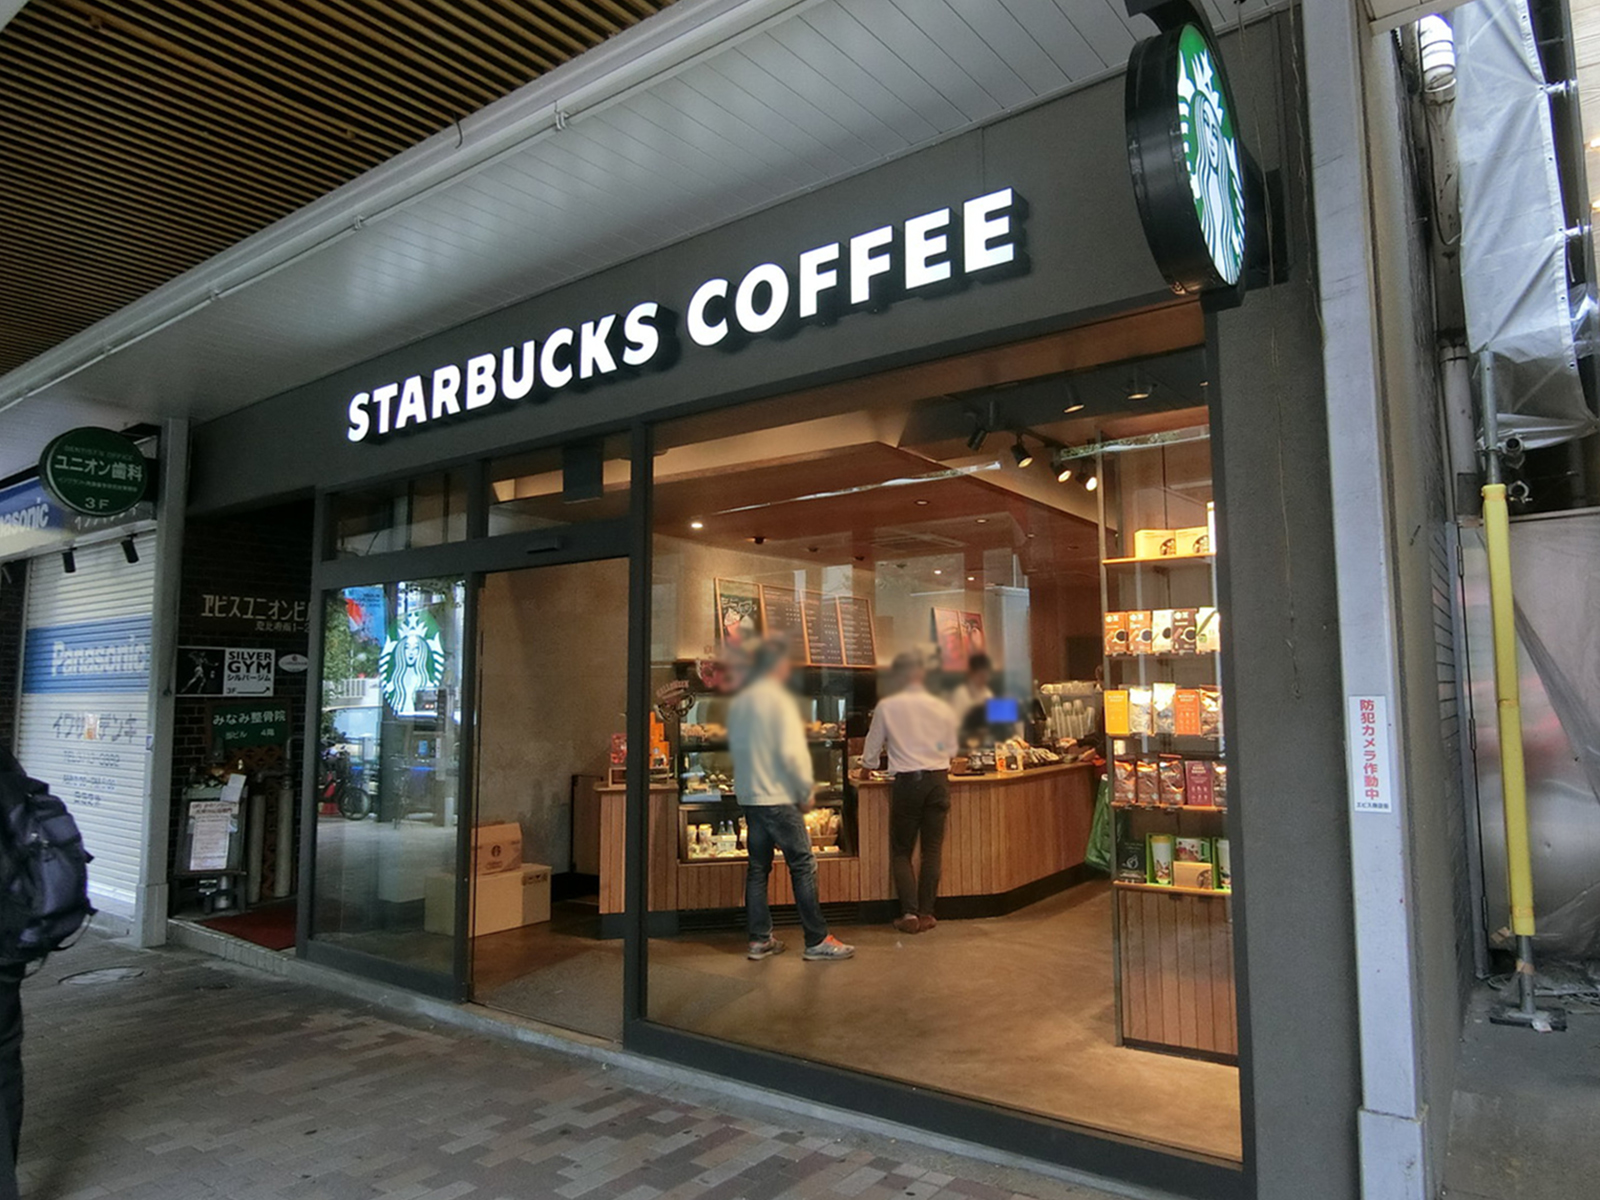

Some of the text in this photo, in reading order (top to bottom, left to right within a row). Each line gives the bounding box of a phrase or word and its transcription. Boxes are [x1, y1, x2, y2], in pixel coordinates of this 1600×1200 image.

[346, 186, 1015, 443] STARBUCKS COFFEE
[54, 455, 143, 482] ユニオン歯科
[51, 634, 147, 677] Panasonic
[228, 651, 273, 661] SILVER
[226, 673, 271, 682] シルバージム
[227, 660, 272, 674] GYM
[212, 709, 286, 726] みなみ整骨院
[1360, 699, 1379, 800] 防犯カメラ作動中
